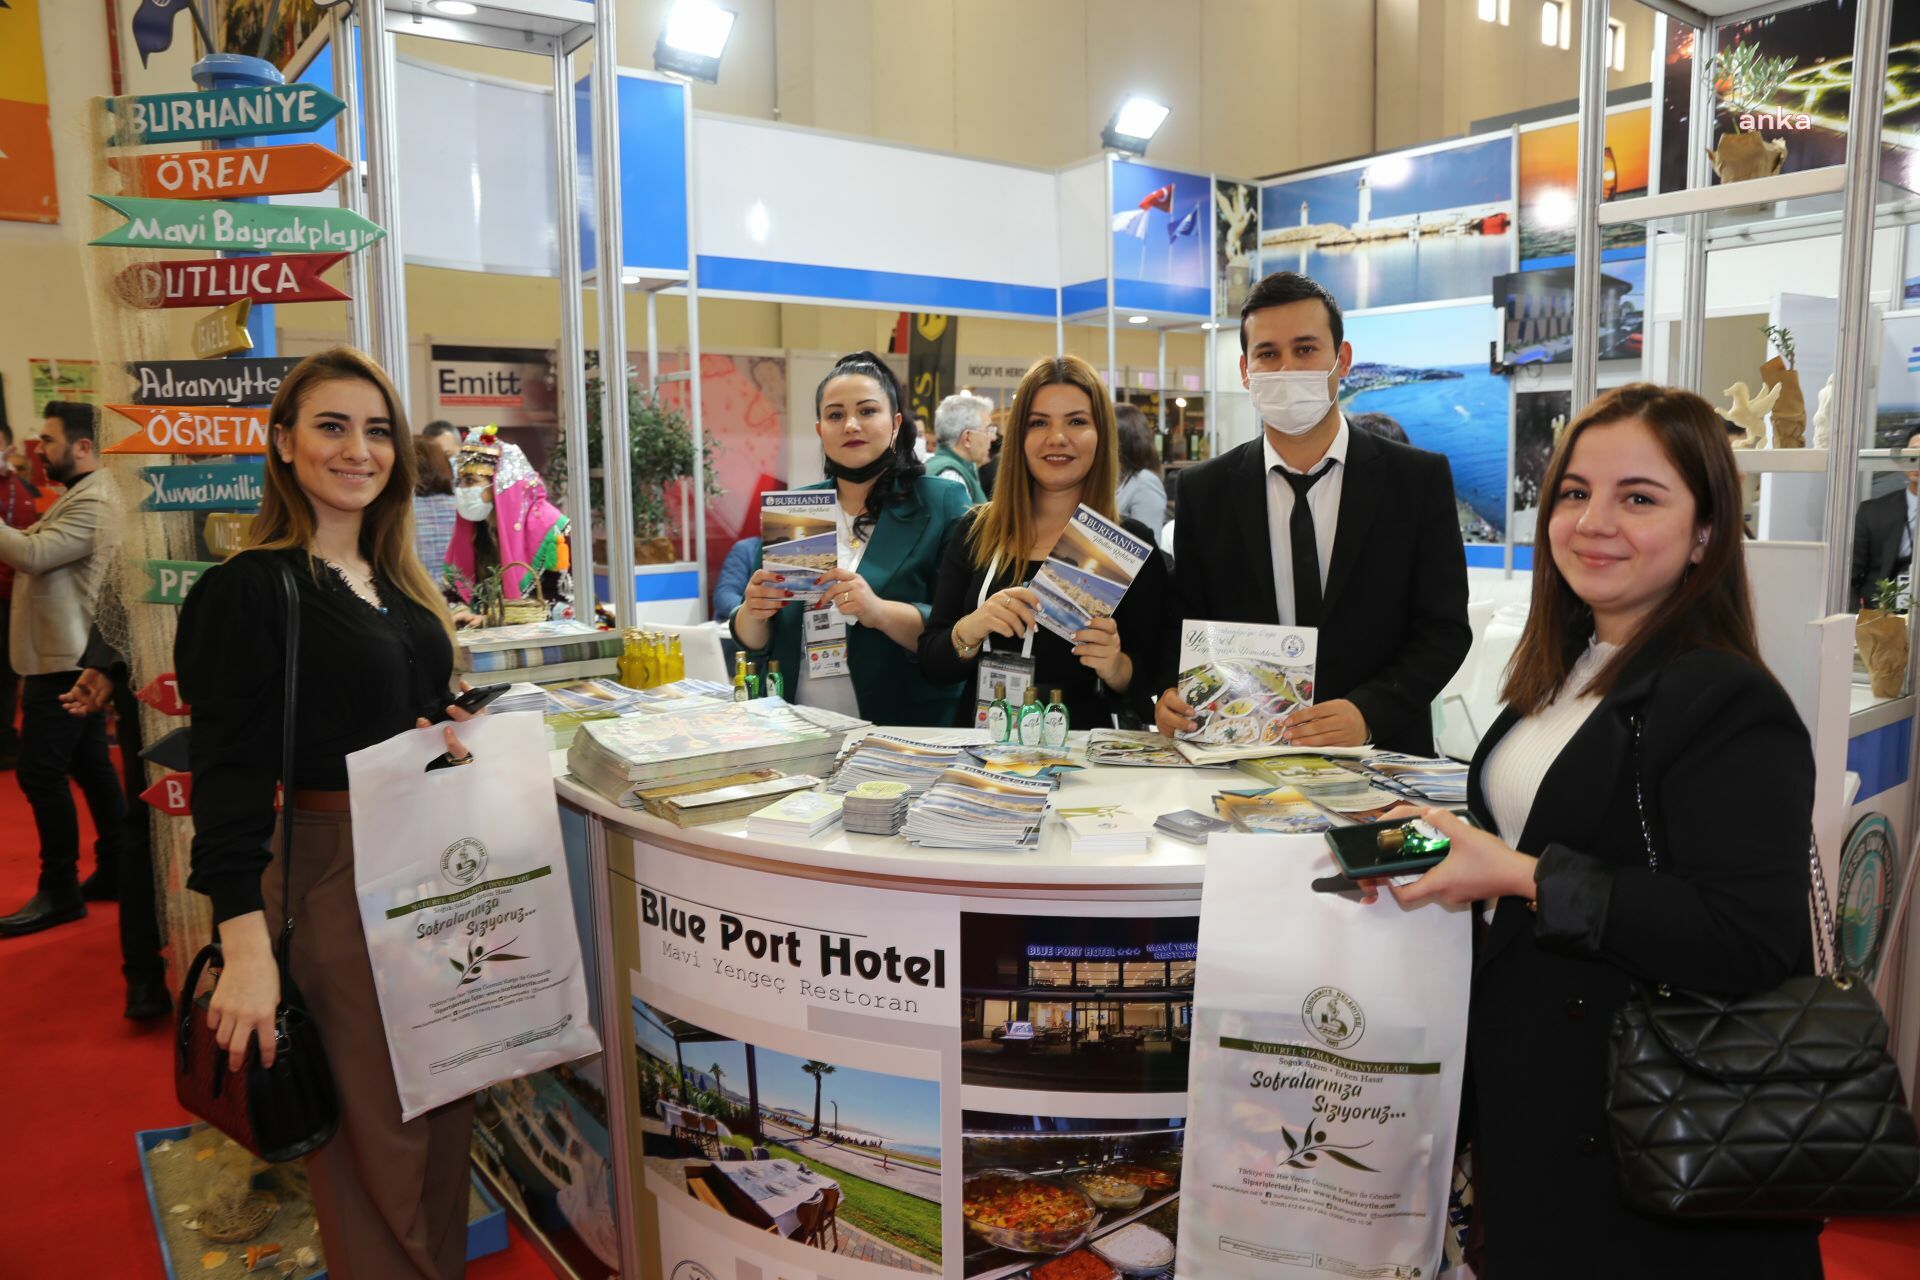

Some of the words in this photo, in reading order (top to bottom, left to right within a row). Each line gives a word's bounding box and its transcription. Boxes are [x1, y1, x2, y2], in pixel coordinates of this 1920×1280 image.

[129, 86, 317, 135] BURHANİYE
[156, 153, 270, 191] ÖREN
[128, 214, 206, 244] Mavi
[142, 262, 300, 300] DUTLUCA
[439, 368, 522, 396] Emitt
[775, 495, 831, 506] BURHANİYE
[1086, 517, 1143, 557] BURHANİYE
[416, 897, 500, 940] Sofralarınıza
[640, 888, 706, 944] Blue
[719, 913, 802, 968] Port
[819, 934, 946, 989] Hotel
[1027, 945, 1054, 957] BLUE
[1055, 945, 1083, 957] PORT
[1084, 946, 1116, 957] HOTEL
[661, 940, 702, 968] Mavi
[711, 957, 787, 993] Yengeç
[799, 978, 920, 1014] Restoran
[1252, 1043, 1297, 1057] NATUREL
[1250, 1069, 1363, 1101] Sofralarınıza
[1311, 1094, 1407, 1125] Sızıyoruz...
